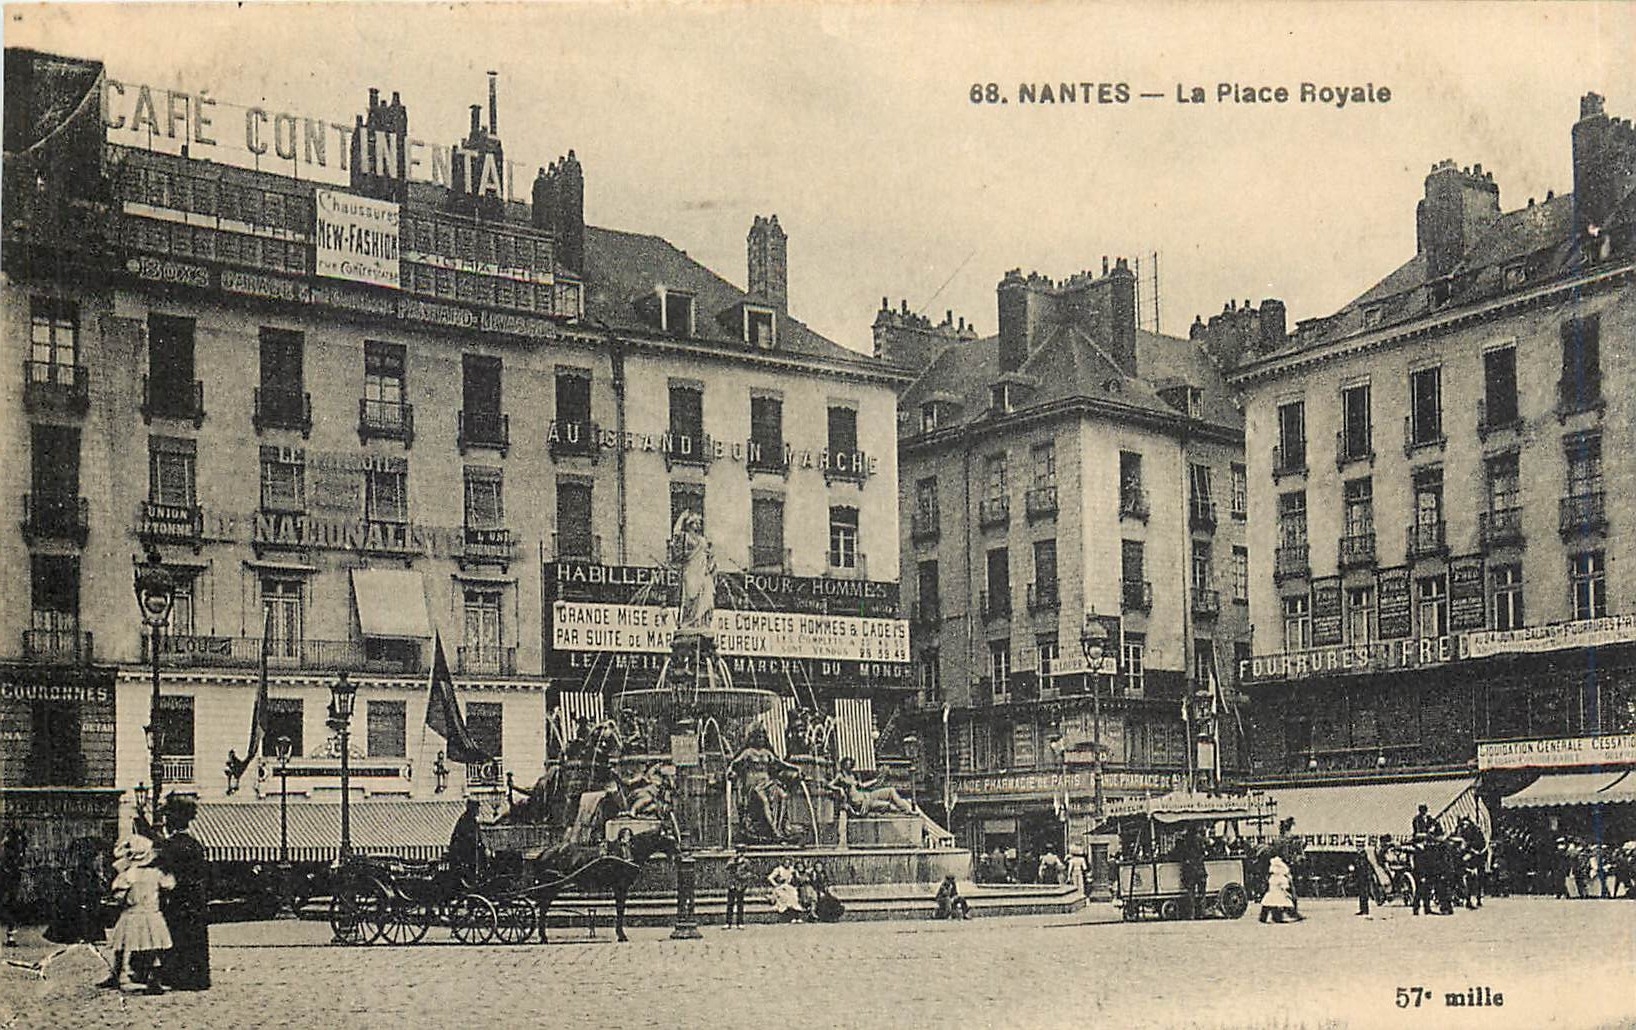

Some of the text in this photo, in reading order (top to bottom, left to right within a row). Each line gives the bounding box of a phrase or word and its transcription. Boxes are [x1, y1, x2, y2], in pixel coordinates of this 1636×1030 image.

[101, 79, 527, 201] CAFÉ CONTINENTAL
[319, 191, 398, 226] Chaussures
[547, 421, 579, 443] AU
[713, 440, 761, 462] BON
[557, 564, 887, 598] HABILLEME POUR HOMMES
[556, 629, 579, 646] PAR
[587, 630, 622, 646] SUITE
[629, 635, 640, 647] DE
[559, 606, 610, 625] GRANDE
[618, 608, 648, 627] MISE
[718, 617, 729, 630] DE
[736, 613, 794, 633] COMPLETS
[800, 618, 845, 636] HOMMES
[862, 621, 905, 638] CADETS
[571, 653, 592, 668] LE
[822, 662, 841, 676] DU
[860, 663, 911, 678] MONDE
[1239, 646, 1370, 679] FOURRURES
[1479, 743, 1533, 757] LIQUIDATION
[984, 776, 1035, 792] PHARMACIE
[1051, 774, 1081, 788] PARIS
